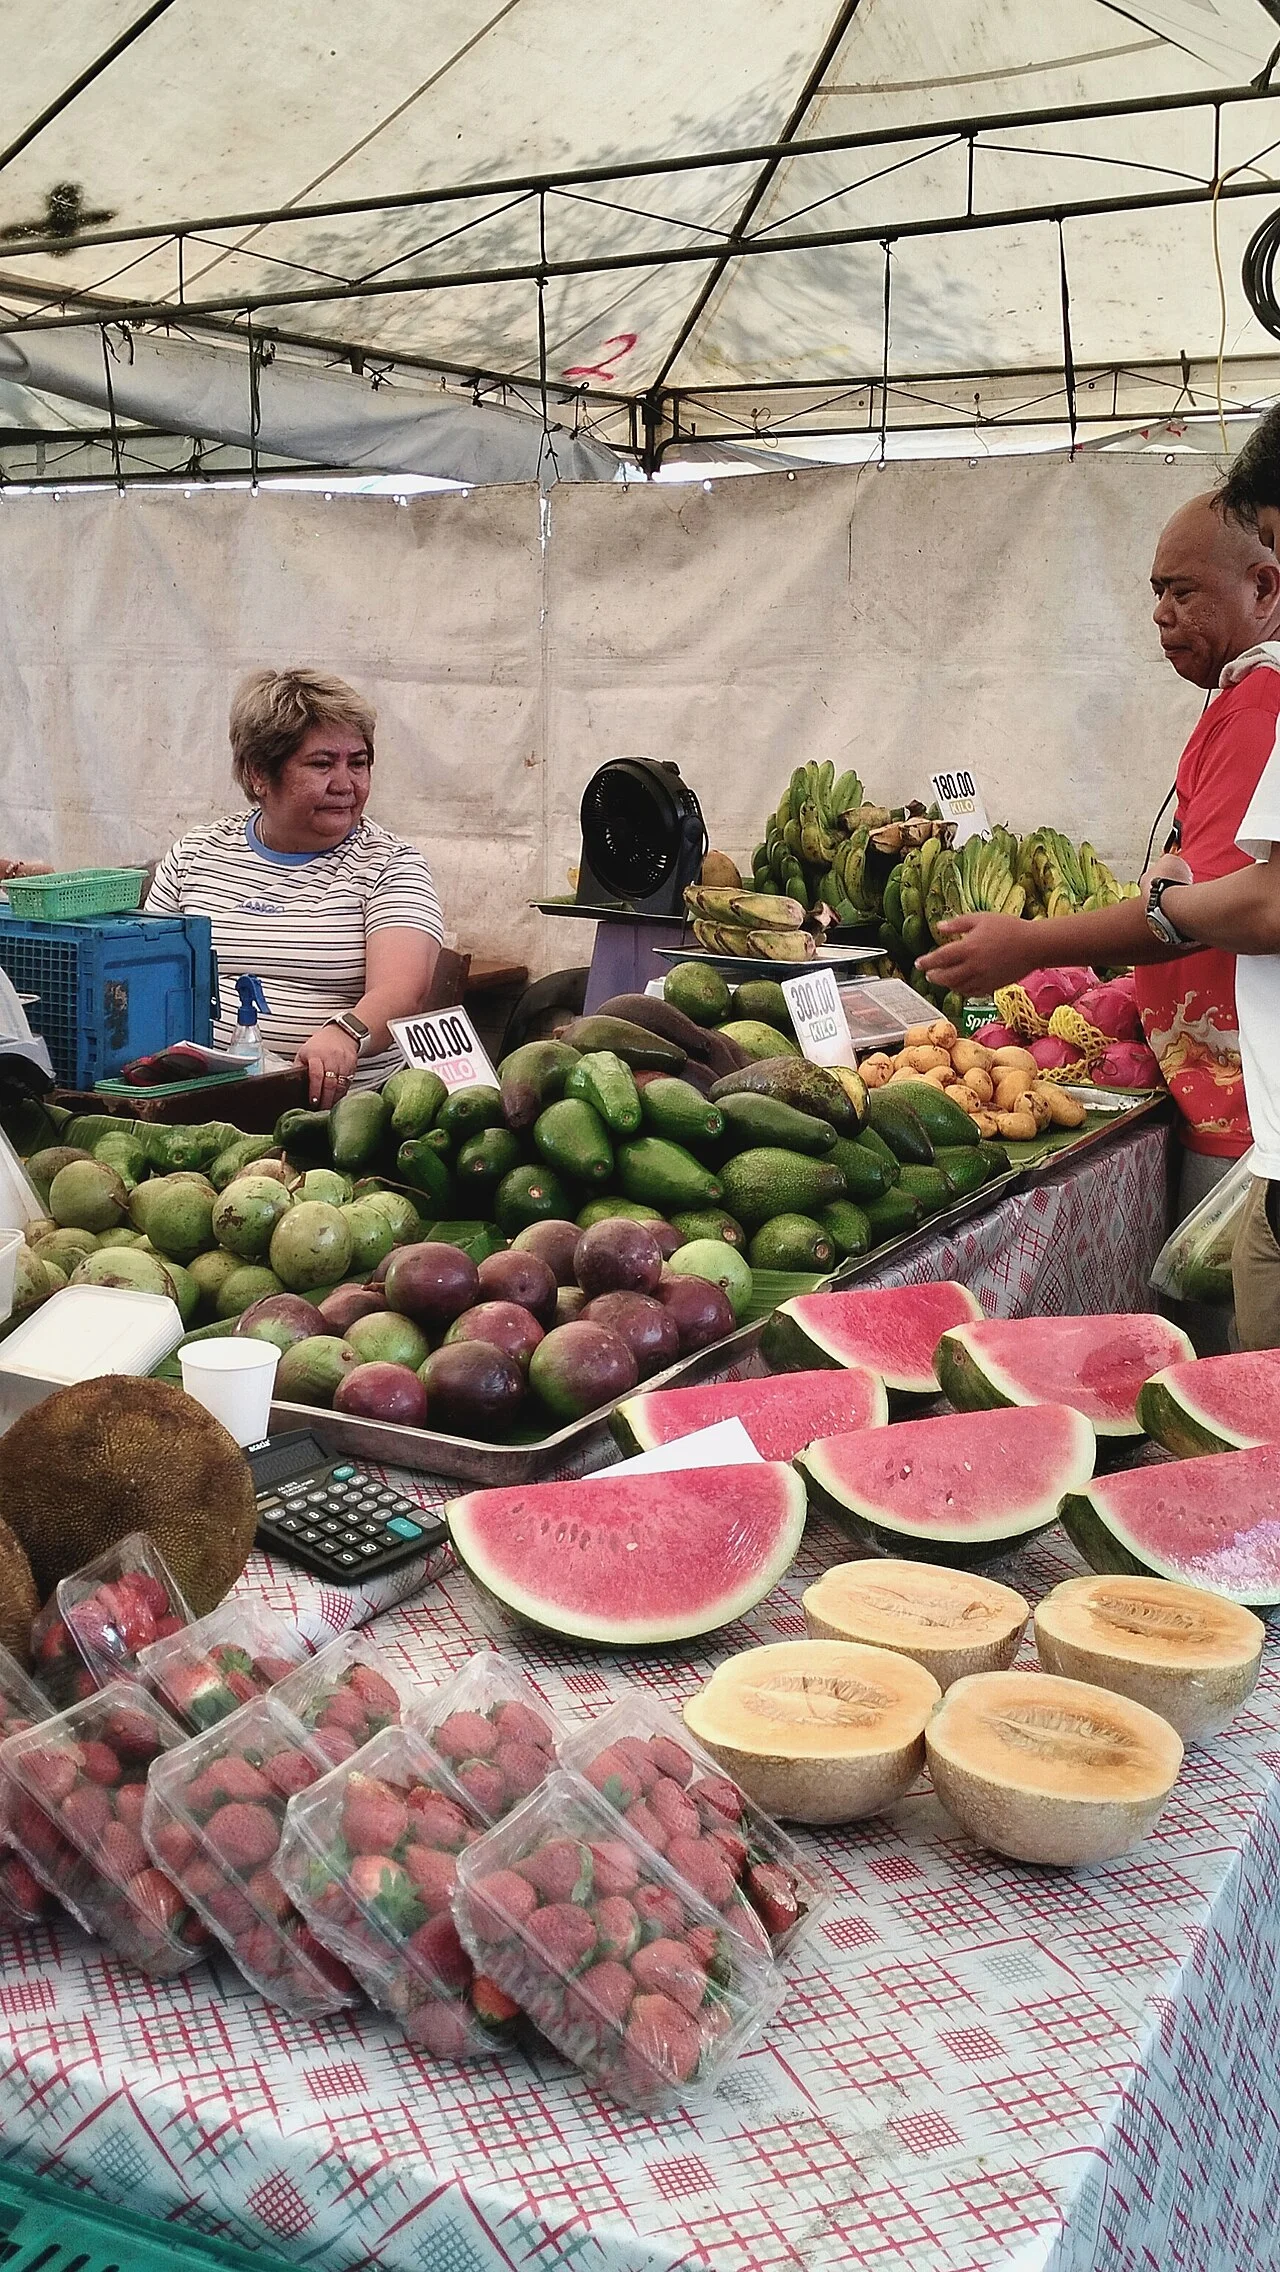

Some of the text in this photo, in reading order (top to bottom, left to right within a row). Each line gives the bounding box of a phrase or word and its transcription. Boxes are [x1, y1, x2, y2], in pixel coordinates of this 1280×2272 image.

[932, 771, 975, 801] 180.00
[949, 800, 974, 815] KILO
[790, 977, 836, 1023] 300.00
[404, 1016, 474, 1064] 400.00
[810, 1018, 836, 1040] KILO
